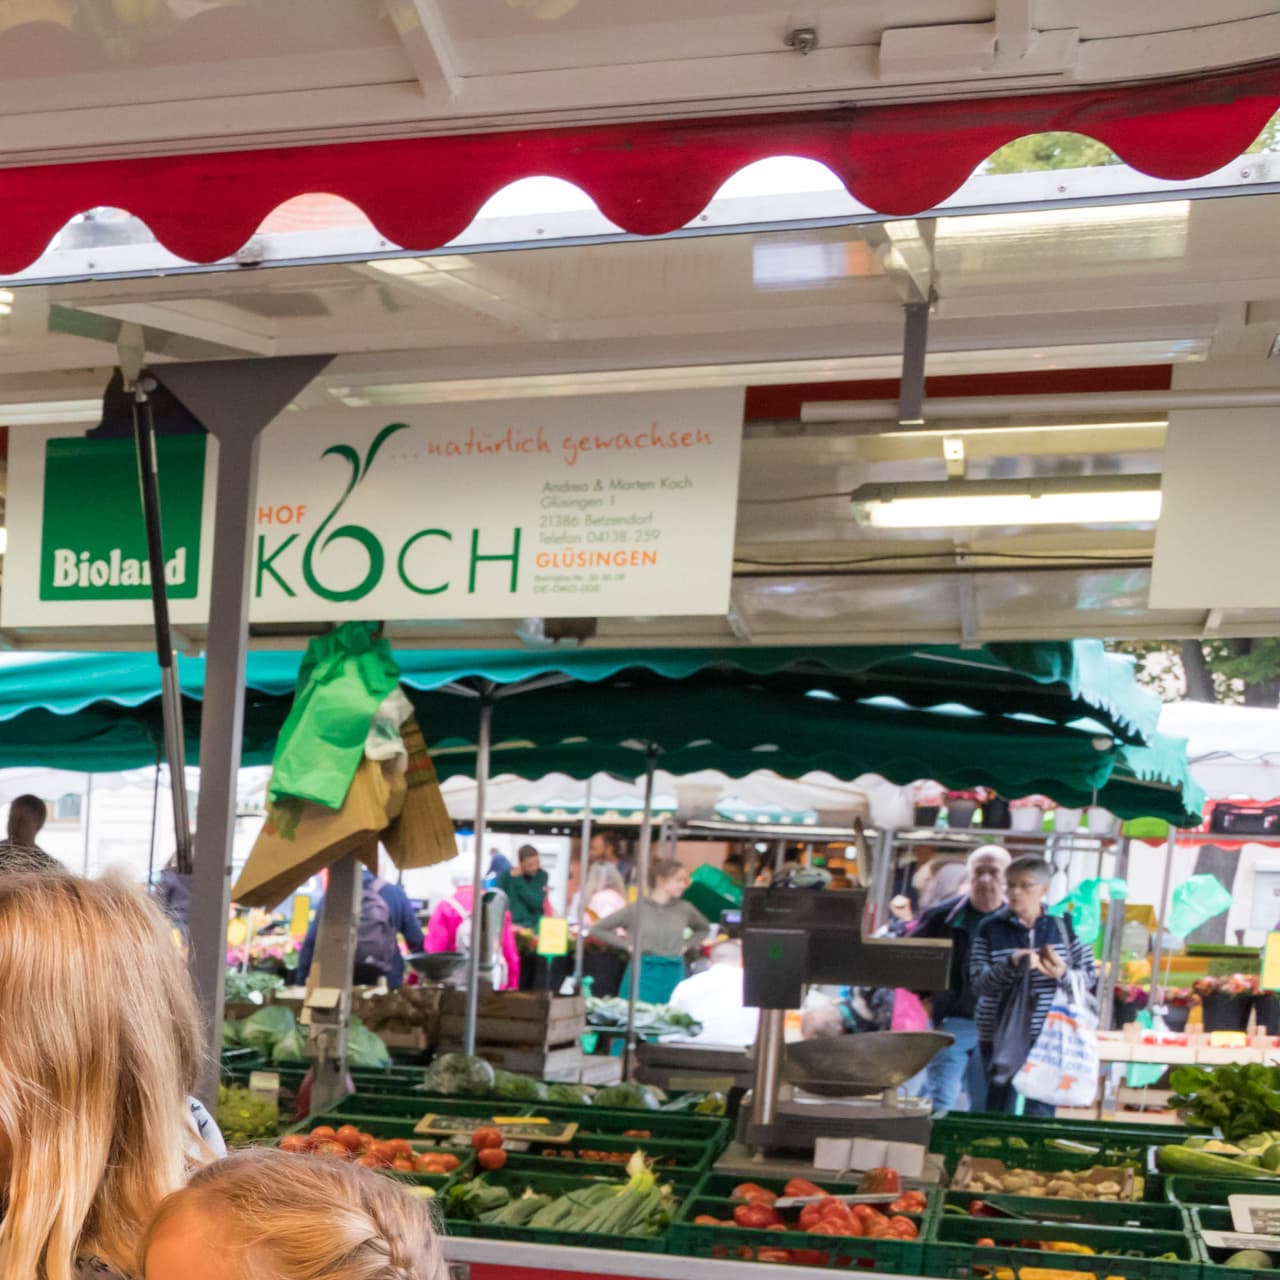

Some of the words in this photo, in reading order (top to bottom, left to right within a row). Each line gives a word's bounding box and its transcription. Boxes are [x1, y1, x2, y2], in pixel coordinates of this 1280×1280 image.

[427, 426, 552, 458] natürlich
[561, 420, 714, 467] gewachsen
[593, 479, 604, 492] &
[659, 475, 694, 490] Koch
[256, 504, 308, 526] HOF
[254, 525, 523, 604] KOCH
[534, 545, 659, 569] GLÜSINGEN
